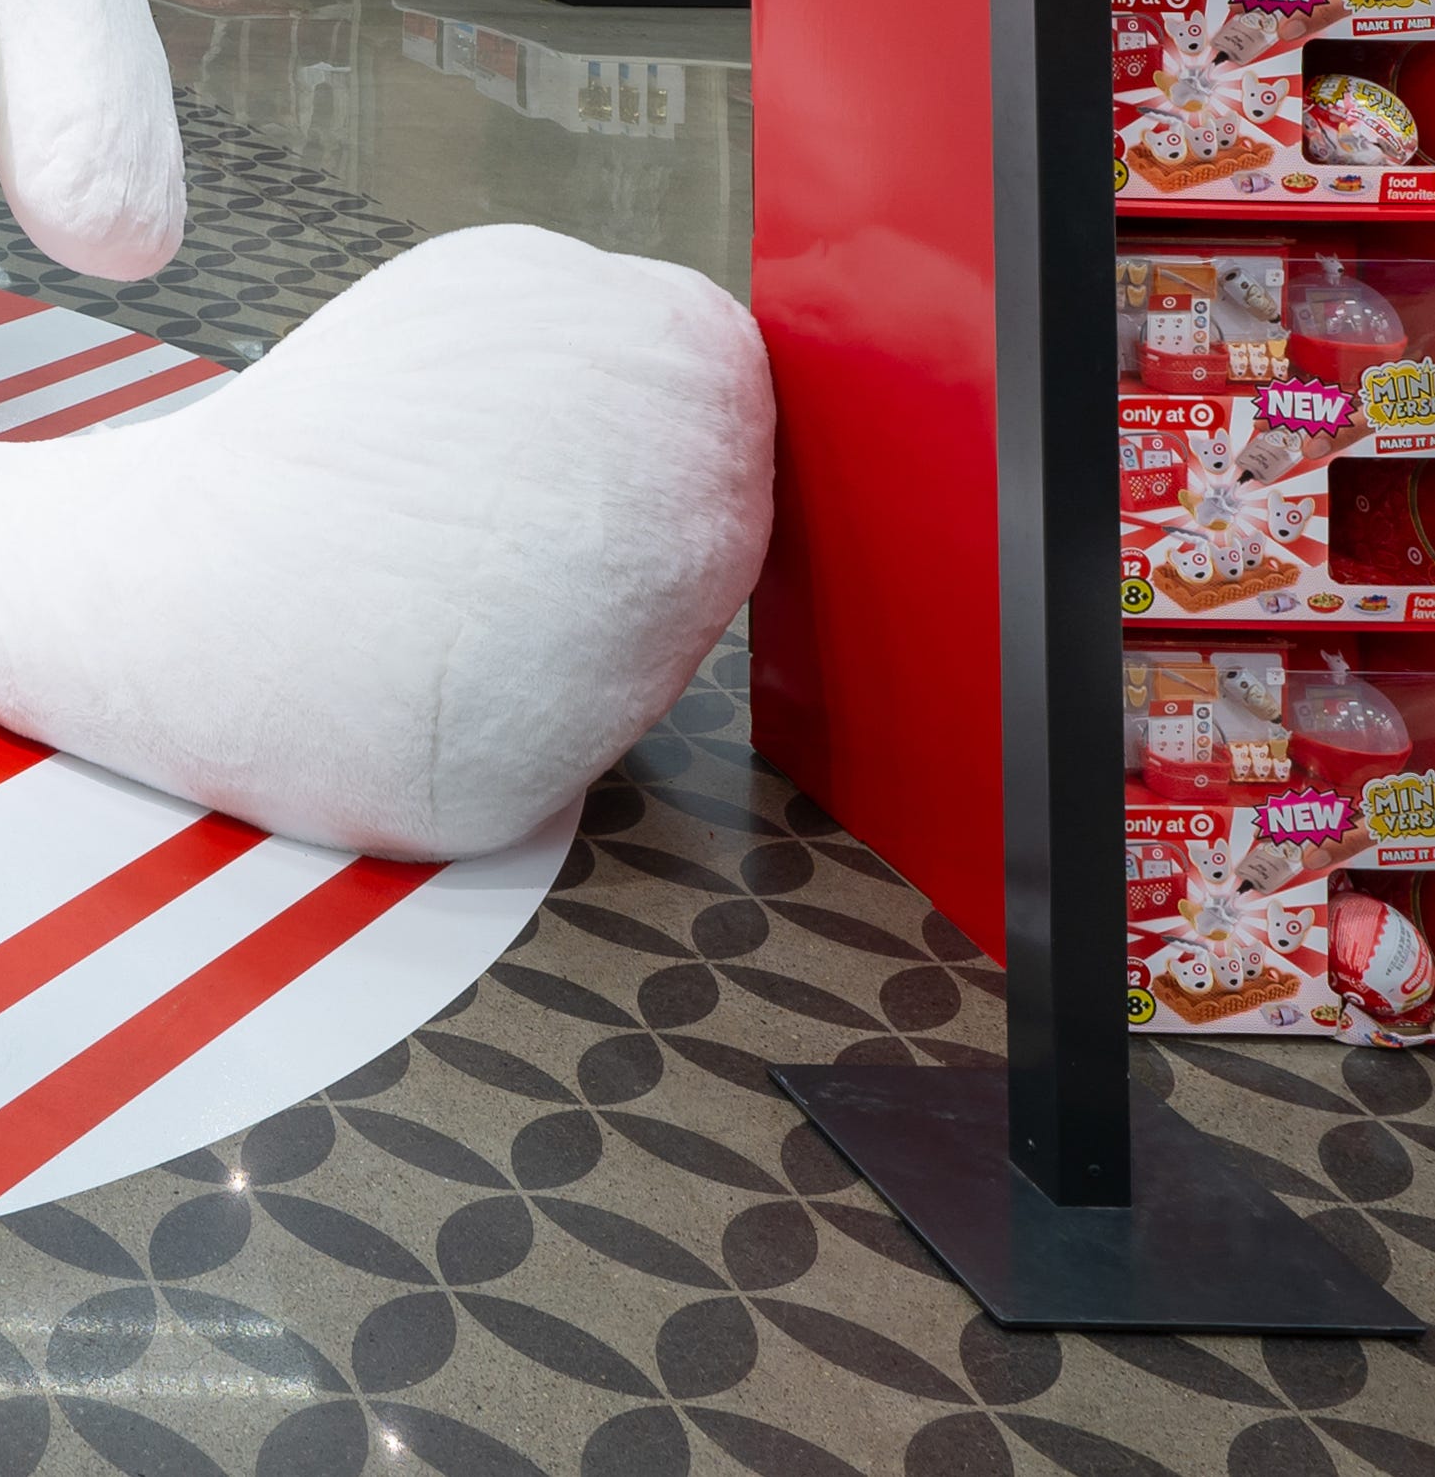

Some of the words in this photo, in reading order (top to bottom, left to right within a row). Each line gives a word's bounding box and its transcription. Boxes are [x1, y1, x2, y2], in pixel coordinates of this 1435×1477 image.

[1357, 19, 1390, 32] MAKE
[1393, 18, 1403, 30] IT
[1388, 176, 1418, 188] food
[1372, 372, 1435, 403] MIN
[1122, 406, 1162, 425] only
[1165, 408, 1185, 423] at
[1267, 390, 1346, 423] NEW
[1379, 437, 1412, 450] MAKE
[1416, 437, 1426, 448] IT
[1122, 561, 1142, 576] 12
[1124, 586, 1149, 605] 8+
[1125, 816, 1162, 836] only
[1165, 817, 1185, 833] at
[1268, 800, 1344, 834] NEW
[1381, 849, 1416, 862] MAKE
[1418, 849, 1429, 860] IT
